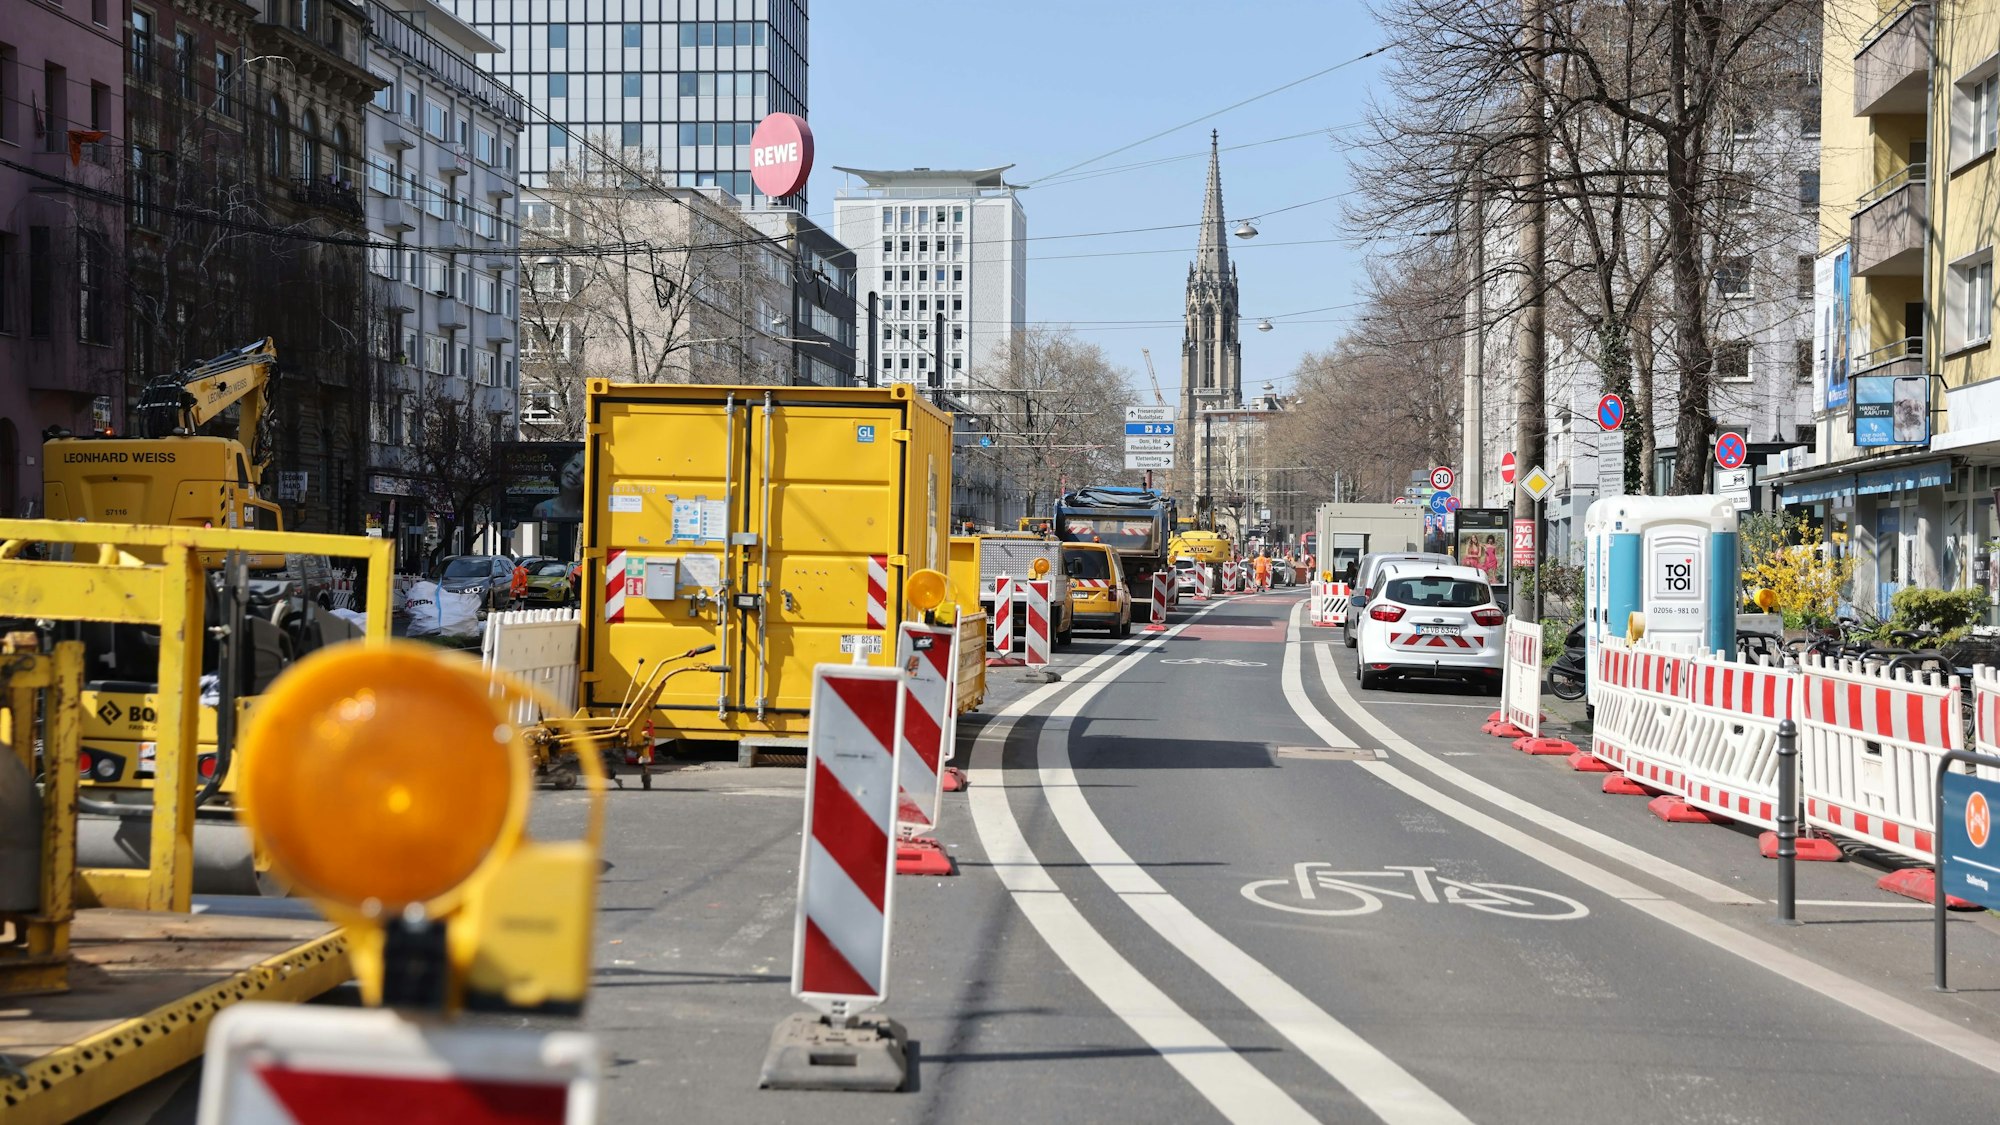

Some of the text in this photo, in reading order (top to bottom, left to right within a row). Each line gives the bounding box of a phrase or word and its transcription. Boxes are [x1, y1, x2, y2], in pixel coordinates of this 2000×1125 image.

[754, 142, 798, 167] REWE
[859, 427, 874, 437] GL
[64, 452, 176, 463] LEONHARD WEISS
[1436, 474, 1449, 484] 30
[1665, 564, 1691, 577] TOI
[1665, 577, 1691, 590] TOI
[842, 635, 881, 644] TARE 825 KG
[842, 644, 852, 652] NET
[873, 645, 881, 653] KG
[129, 706, 157, 722] BO
